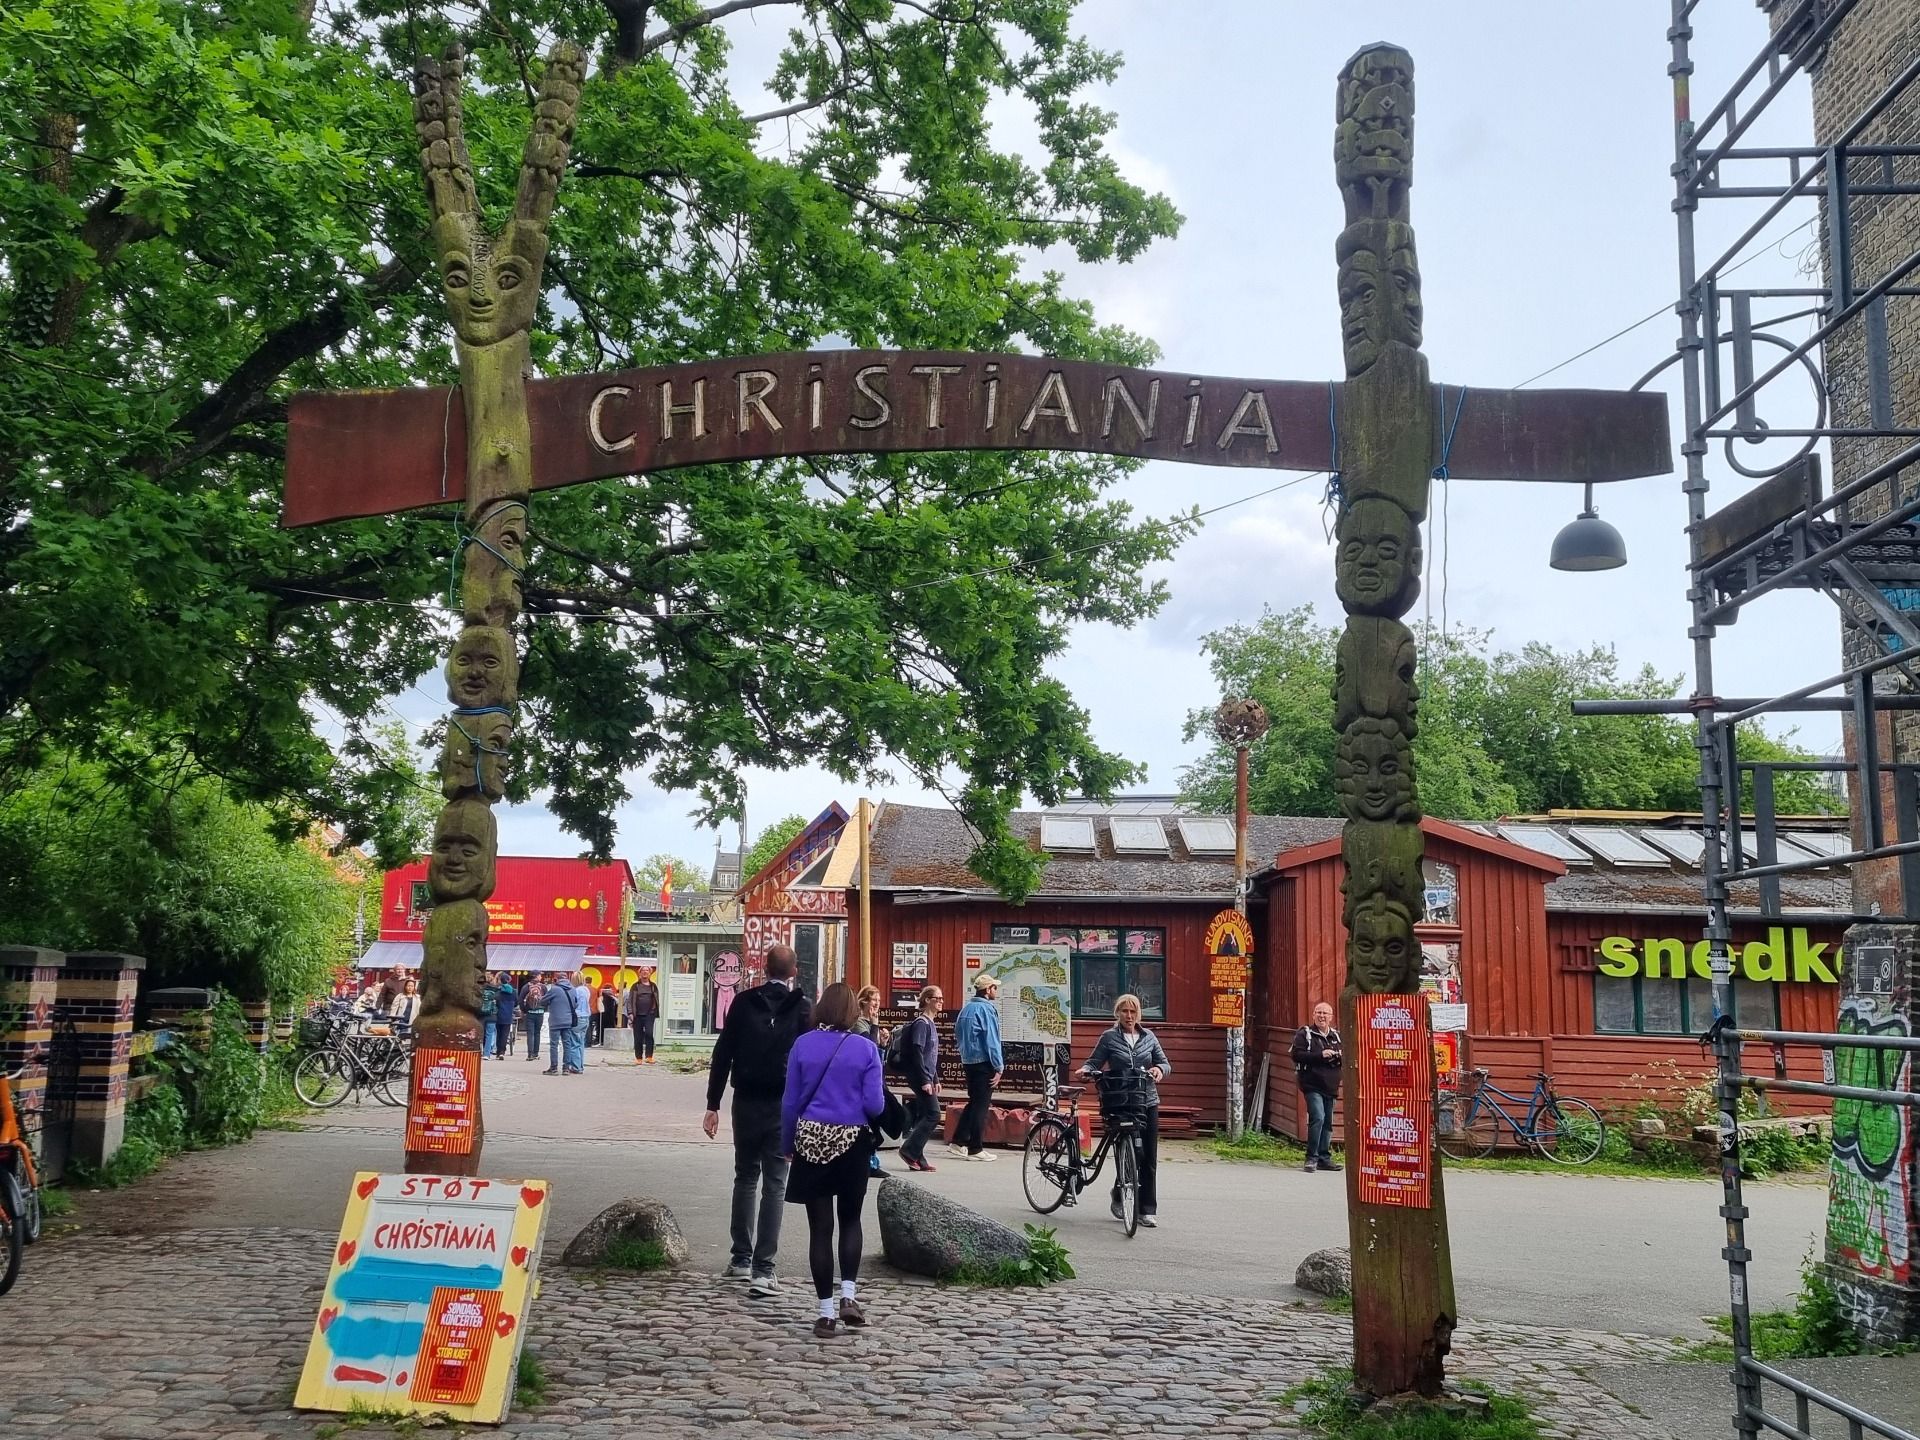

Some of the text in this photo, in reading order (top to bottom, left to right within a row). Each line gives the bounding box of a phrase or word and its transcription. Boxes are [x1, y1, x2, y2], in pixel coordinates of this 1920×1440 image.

[1204, 909, 1254, 947] RUNDVISNING
[1598, 927, 1842, 983] snedk
[715, 958, 740, 973] 2nd
[1375, 1008, 1410, 1019] SØNDAGS
[1371, 1018, 1415, 1030] KONCERTER
[1376, 1049, 1412, 1060] STOR KAEFT
[428, 1066, 464, 1080] SØNDAGS
[422, 1078, 467, 1091] KONCERTER
[1375, 1116, 1414, 1130] SØNDAGS
[1370, 1127, 1418, 1142] KONCERTER
[400, 1177, 490, 1200] STØT
[447, 1302, 482, 1315] SØNDAGS
[440, 1314, 483, 1328] KONCERTER
[436, 1347, 472, 1360] STOR KAEFT
